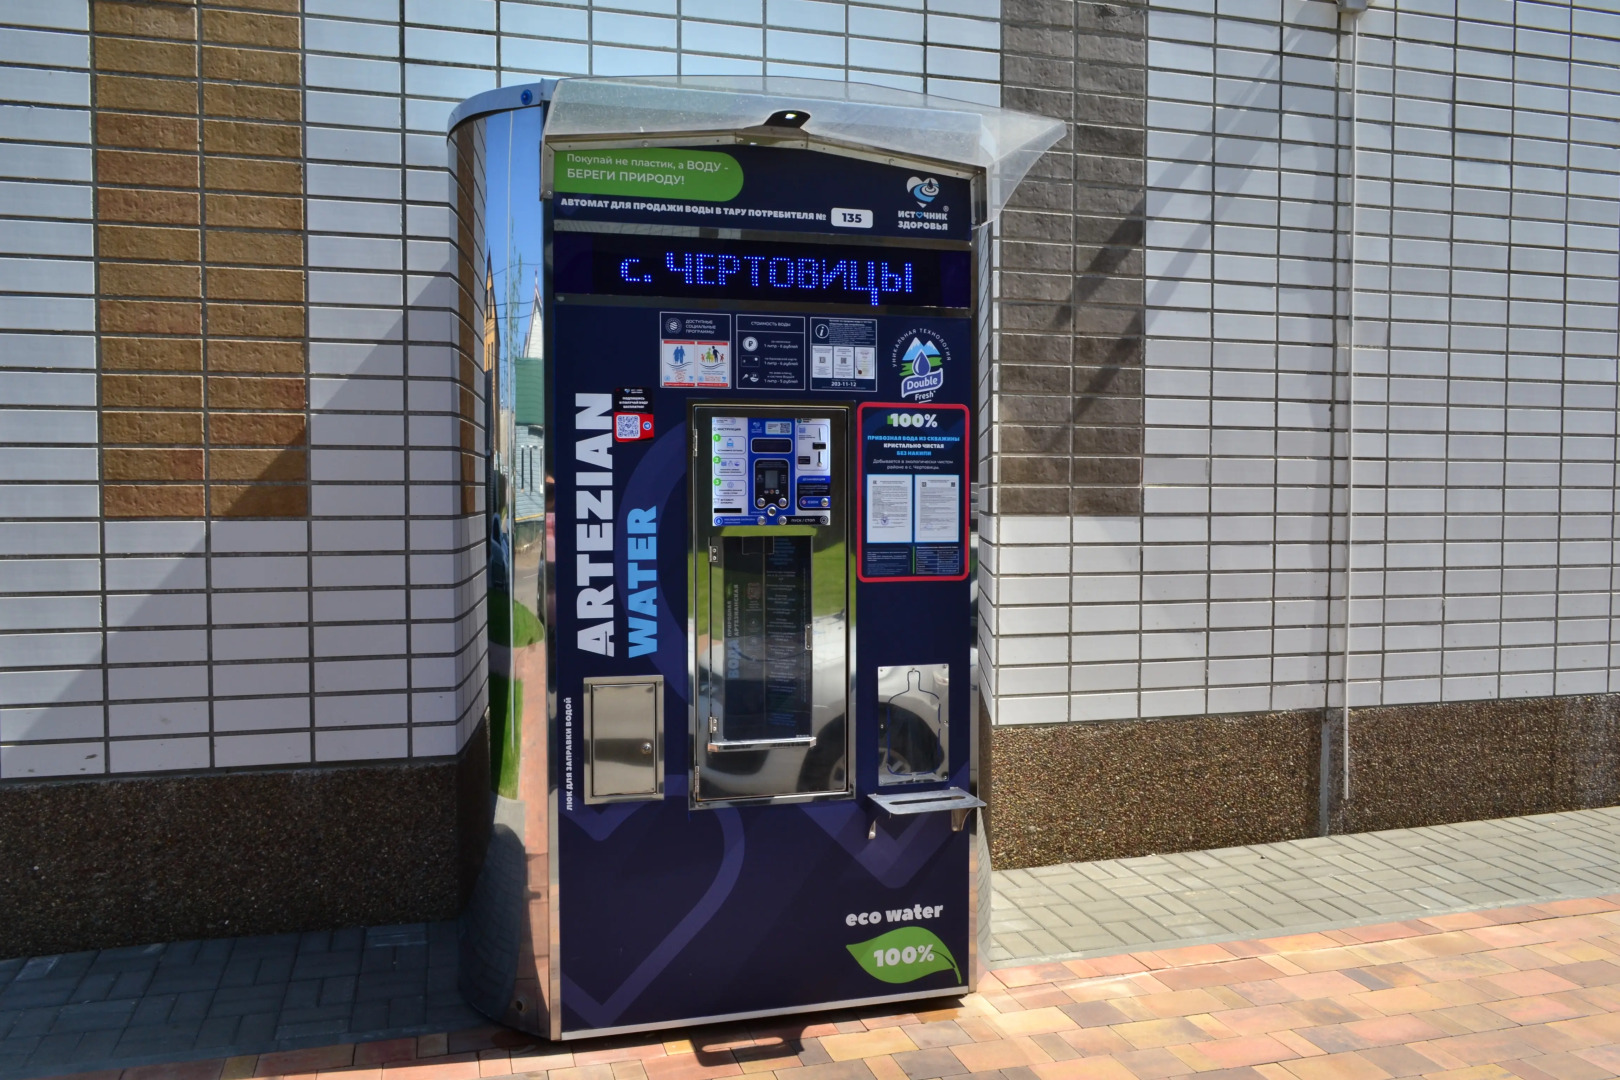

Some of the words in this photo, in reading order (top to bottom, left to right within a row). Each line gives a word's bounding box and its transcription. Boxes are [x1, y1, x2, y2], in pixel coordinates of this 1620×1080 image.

[567, 153, 613, 166] Покупай
[615, 158, 628, 166] не
[631, 158, 676, 170] пластик,
[678, 162, 684, 170] а
[686, 160, 721, 173] ВОДУ
[567, 168, 616, 181] БЕРЕГИ
[619, 171, 685, 186] ПРИРОДУ!
[561, 198, 609, 208] АВТОМАТ
[610, 200, 632, 210] ДЛЯ
[633, 202, 683, 213] ПРОДАЖИ
[685, 205, 714, 215] ВОДЫ
[715, 206, 722, 215] В
[723, 207, 747, 217] ТАРУ
[748, 209, 814, 220] ПОТРЕБИТЕЛЯ
[842, 212, 863, 224] 135
[898, 220, 948, 231] ЗДОРОВЬЯ
[666, 252, 912, 306] ЧЕРТОВИЦЫ
[892, 328, 917, 368] УНИКАЛЬНАЯ
[920, 328, 952, 361] ТЕХНОЛОГИЯ
[907, 376, 938, 390] Double
[890, 413, 938, 428] 100%
[575, 393, 614, 657] ARTEZIAN
[627, 505, 658, 658] WATER
[728, 639, 740, 679] ВОДА
[563, 697, 572, 727] ВОДОЙ
[845, 911, 882, 927] eco
[885, 904, 944, 923] water
[874, 944, 935, 967] 100%
